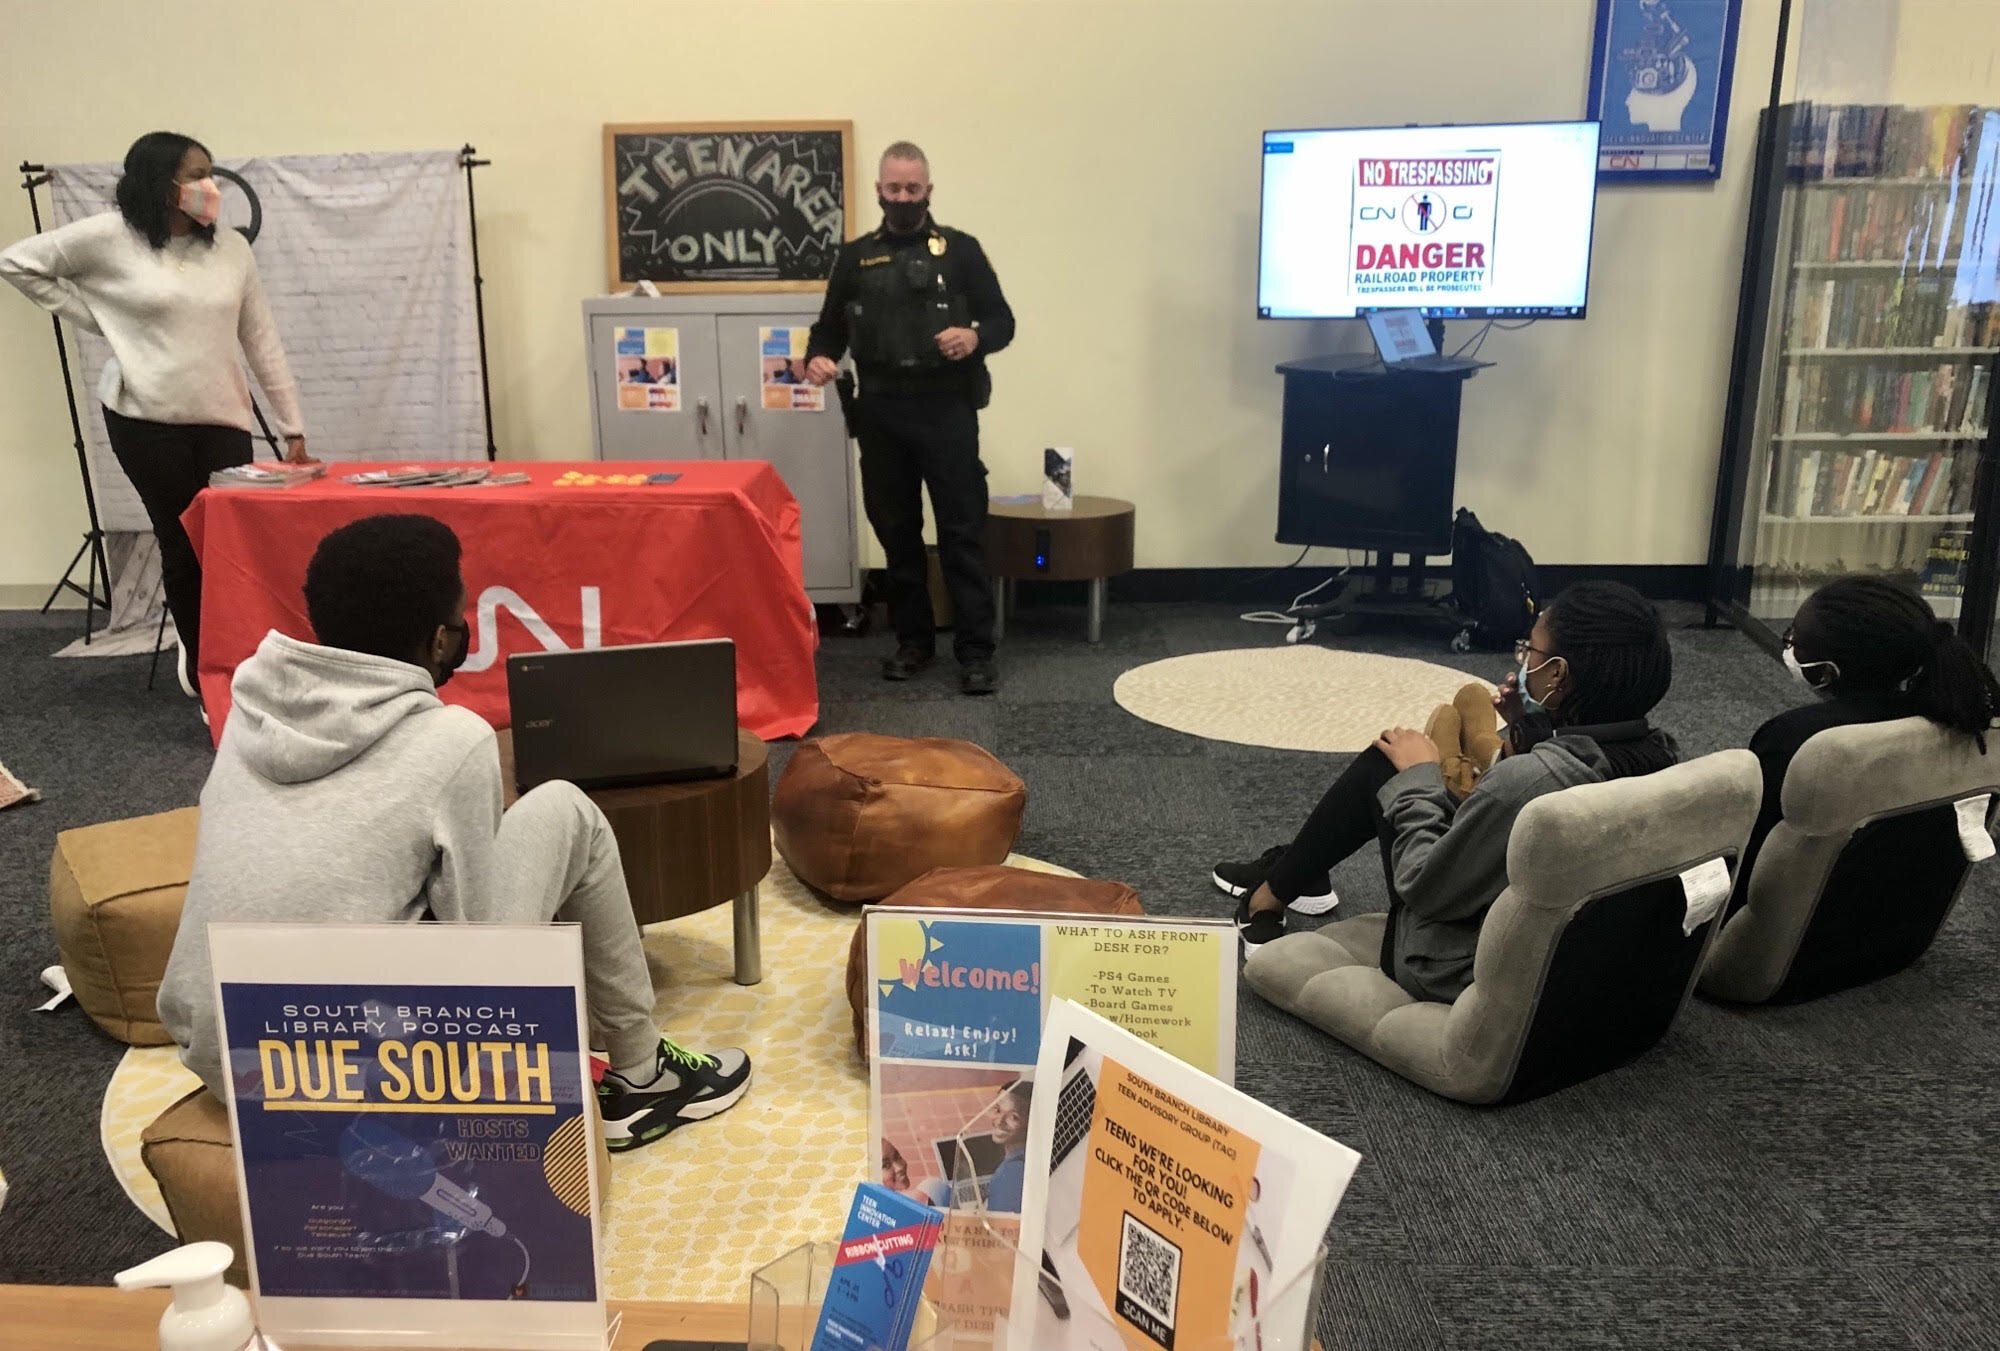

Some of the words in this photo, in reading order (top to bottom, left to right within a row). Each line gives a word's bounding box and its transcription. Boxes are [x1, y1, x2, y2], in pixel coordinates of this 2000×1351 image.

[1363, 161, 1386, 186] NO
[1389, 160, 1489, 186] TRESPASSING
[1610, 156, 1640, 170] CN
[620, 137, 755, 202] TEEN
[746, 150, 844, 245] AREA
[1360, 206, 1396, 220] CN
[671, 226, 781, 265] ONLY
[1356, 242, 1486, 270] DANGER
[1355, 271, 1417, 284] RAILROAD
[1420, 270, 1485, 283] PROPERTY
[1056, 925, 1099, 937] WHAT
[1104, 928, 1123, 938] TO
[1128, 929, 1157, 941] ASK
[1161, 931, 1209, 943] FRONT
[1094, 942, 1130, 953] DESK
[1134, 944, 1169, 955] FOR?
[898, 958, 1040, 995] Welcome!
[1093, 971, 1123, 981] -PS4
[1127, 972, 1170, 984] Games
[1112, 985, 1153, 997] Watch
[1158, 988, 1177, 998] TV
[283, 1004, 380, 1018] SOUTH
[397, 1006, 516, 1019] BRANCH
[1131, 1000, 1174, 1012] Games
[265, 1021, 386, 1034] LIBRARY
[402, 1022, 540, 1036] PODCAST
[1109, 1014, 1192, 1027] w/Homework
[904, 1022, 955, 1040] Relax!
[963, 1026, 1017, 1045] Enjoy!
[944, 1042, 978, 1058] Ask!
[258, 1039, 365, 1100] DUE
[377, 1039, 552, 1102] SOUTH
[1127, 1072, 1153, 1096] SOUTH
[1154, 1088, 1190, 1115] BRANCH
[1191, 1109, 1230, 1137] LIBRARY
[458, 1118, 529, 1138] HOSTS
[1118, 1082, 1137, 1101] TEEN
[1138, 1096, 1179, 1126] ADVISORY
[1179, 1120, 1212, 1144] GROUP
[1212, 1138, 1237, 1162] (TAG)
[445, 1143, 541, 1162] WANTED
[1105, 1117, 1137, 1149] TEENS
[1138, 1138, 1174, 1173] WE'RE
[1176, 1162, 1234, 1209] LOOKING
[1133, 1153, 1156, 1179] FOR
[1159, 1169, 1188, 1200] YOU!
[862, 1194, 878, 1210] TEEN
[1095, 1147, 1123, 1174] CLICK
[1125, 1166, 1143, 1187] THE
[1144, 1180, 1160, 1200] QR
[1162, 1191, 1192, 1218] CODE
[1193, 1212, 1234, 1247] BELOW
[859, 1203, 897, 1229] INNOVATION
[1132, 1187, 1147, 1205] TO
[1147, 1199, 1185, 1232] APPLY.
[857, 1212, 881, 1229] CENTER
[845, 1239, 878, 1258] RIBBON
[878, 1233, 914, 1252] CUTTING
[1123, 1300, 1150, 1330] SCAN
[1151, 1320, 1168, 1344] ME
